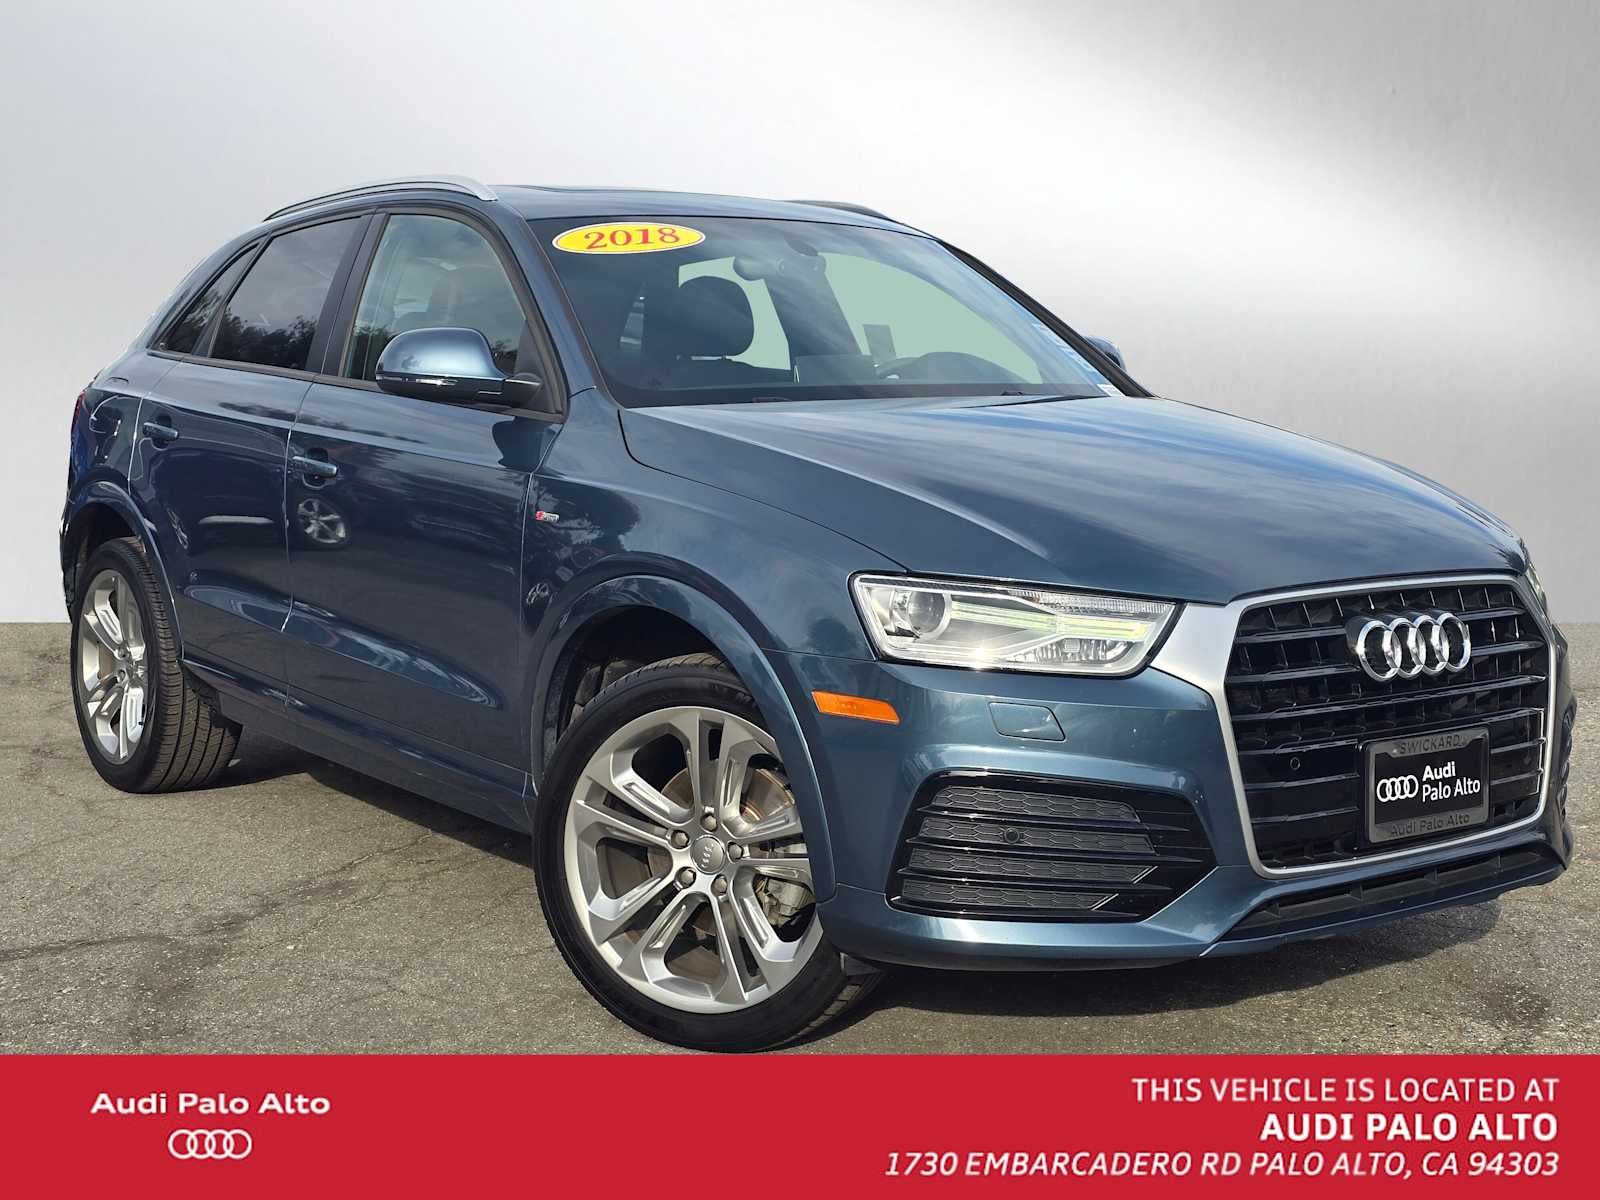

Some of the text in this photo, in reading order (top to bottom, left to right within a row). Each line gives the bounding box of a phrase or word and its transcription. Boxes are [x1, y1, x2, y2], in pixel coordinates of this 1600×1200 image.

[584, 227, 680, 250] 2018
[1399, 734, 1461, 754] SWICKARD
[1422, 761, 1456, 781] Audi
[1422, 777, 1481, 802] Palo Alto
[1391, 813, 1471, 837] Audi Palo Alto
